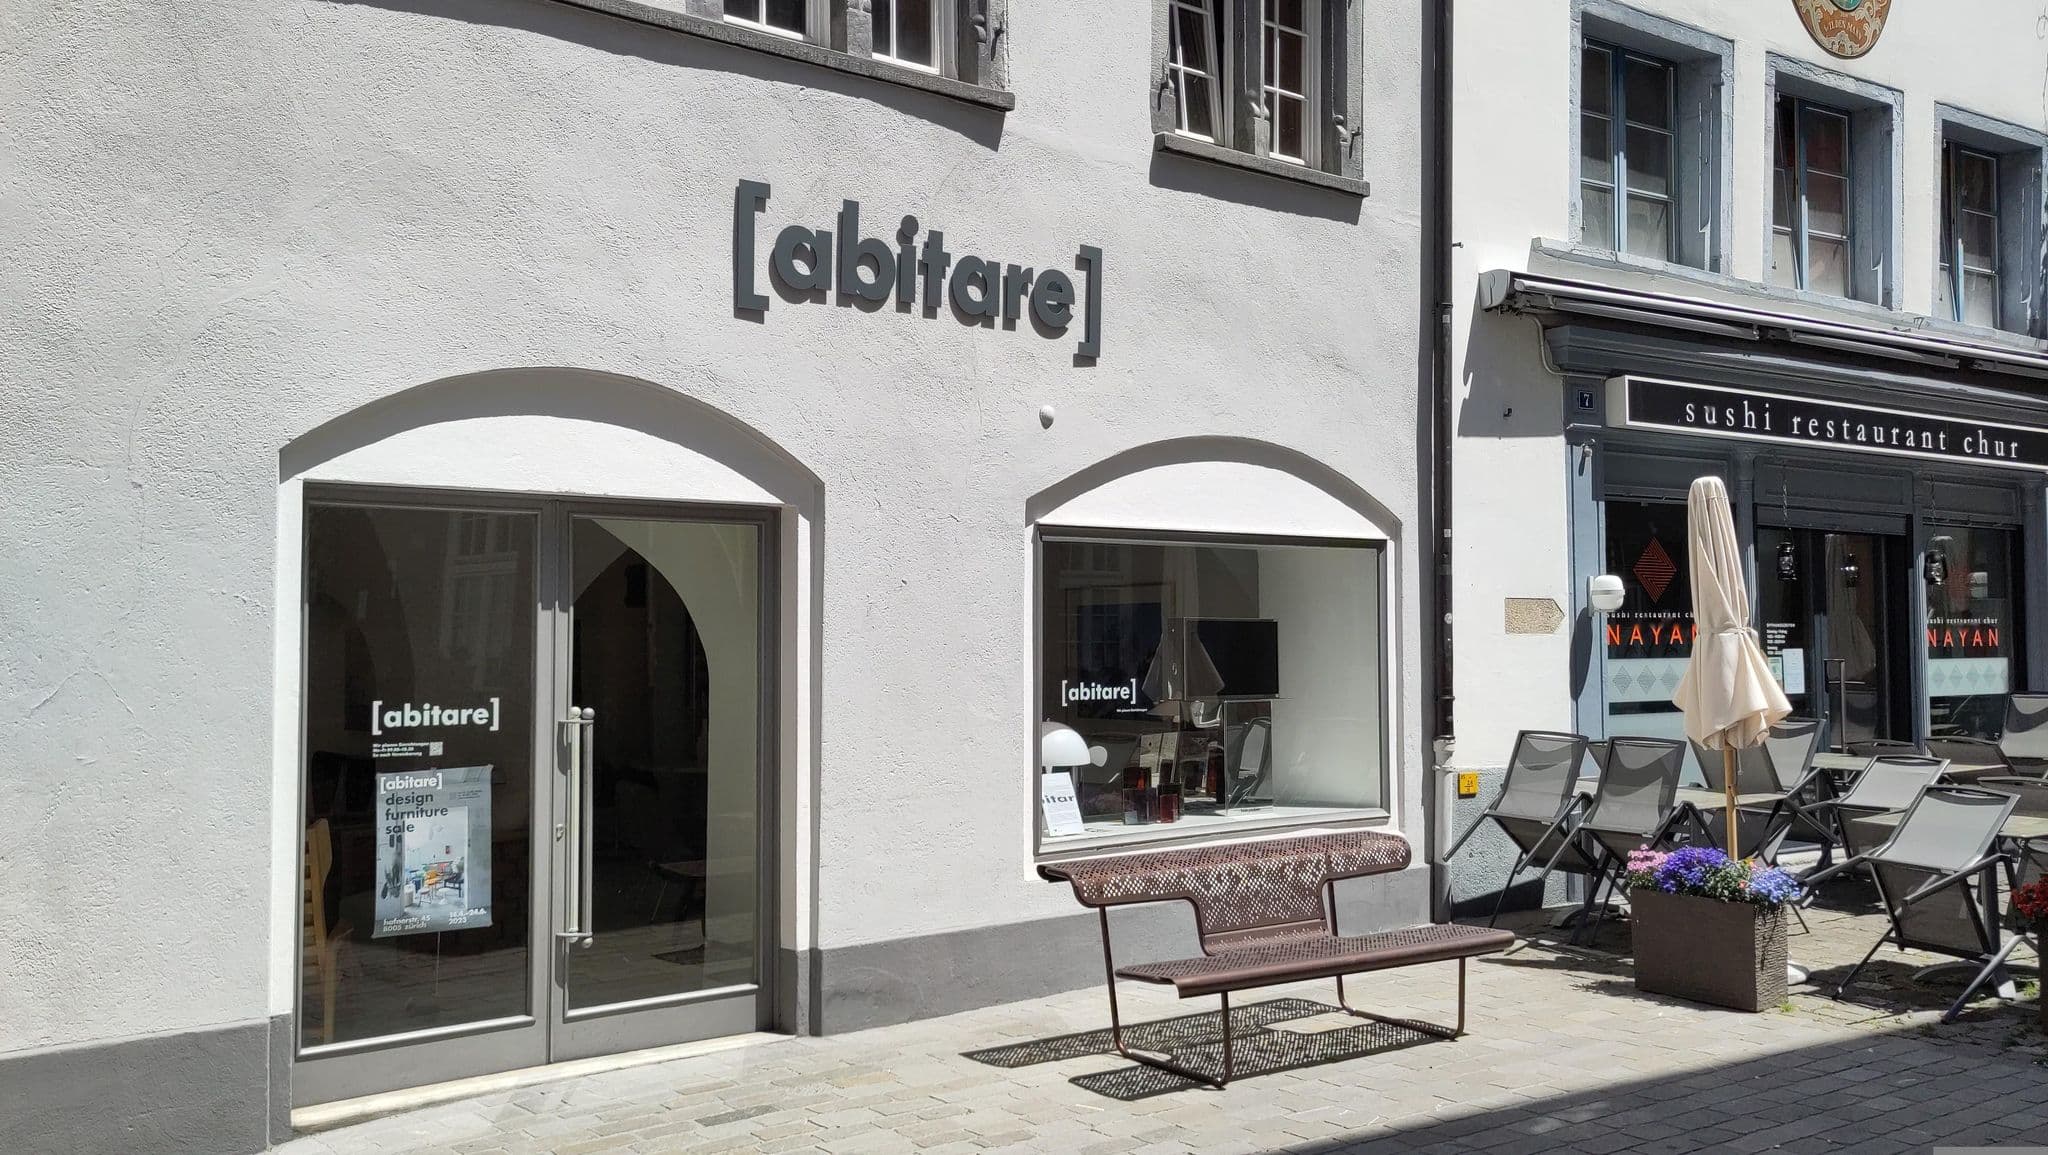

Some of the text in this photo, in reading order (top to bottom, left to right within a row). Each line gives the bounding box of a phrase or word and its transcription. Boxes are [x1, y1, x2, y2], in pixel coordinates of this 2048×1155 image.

[1583, 393, 1590, 407] 7
[1685, 400, 2019, 459] sushi restaurant chur
[1926, 628, 1999, 648] NAYAN
[385, 791, 434, 806] design
[385, 806, 449, 821] furniture
[385, 820, 415, 835] sale
